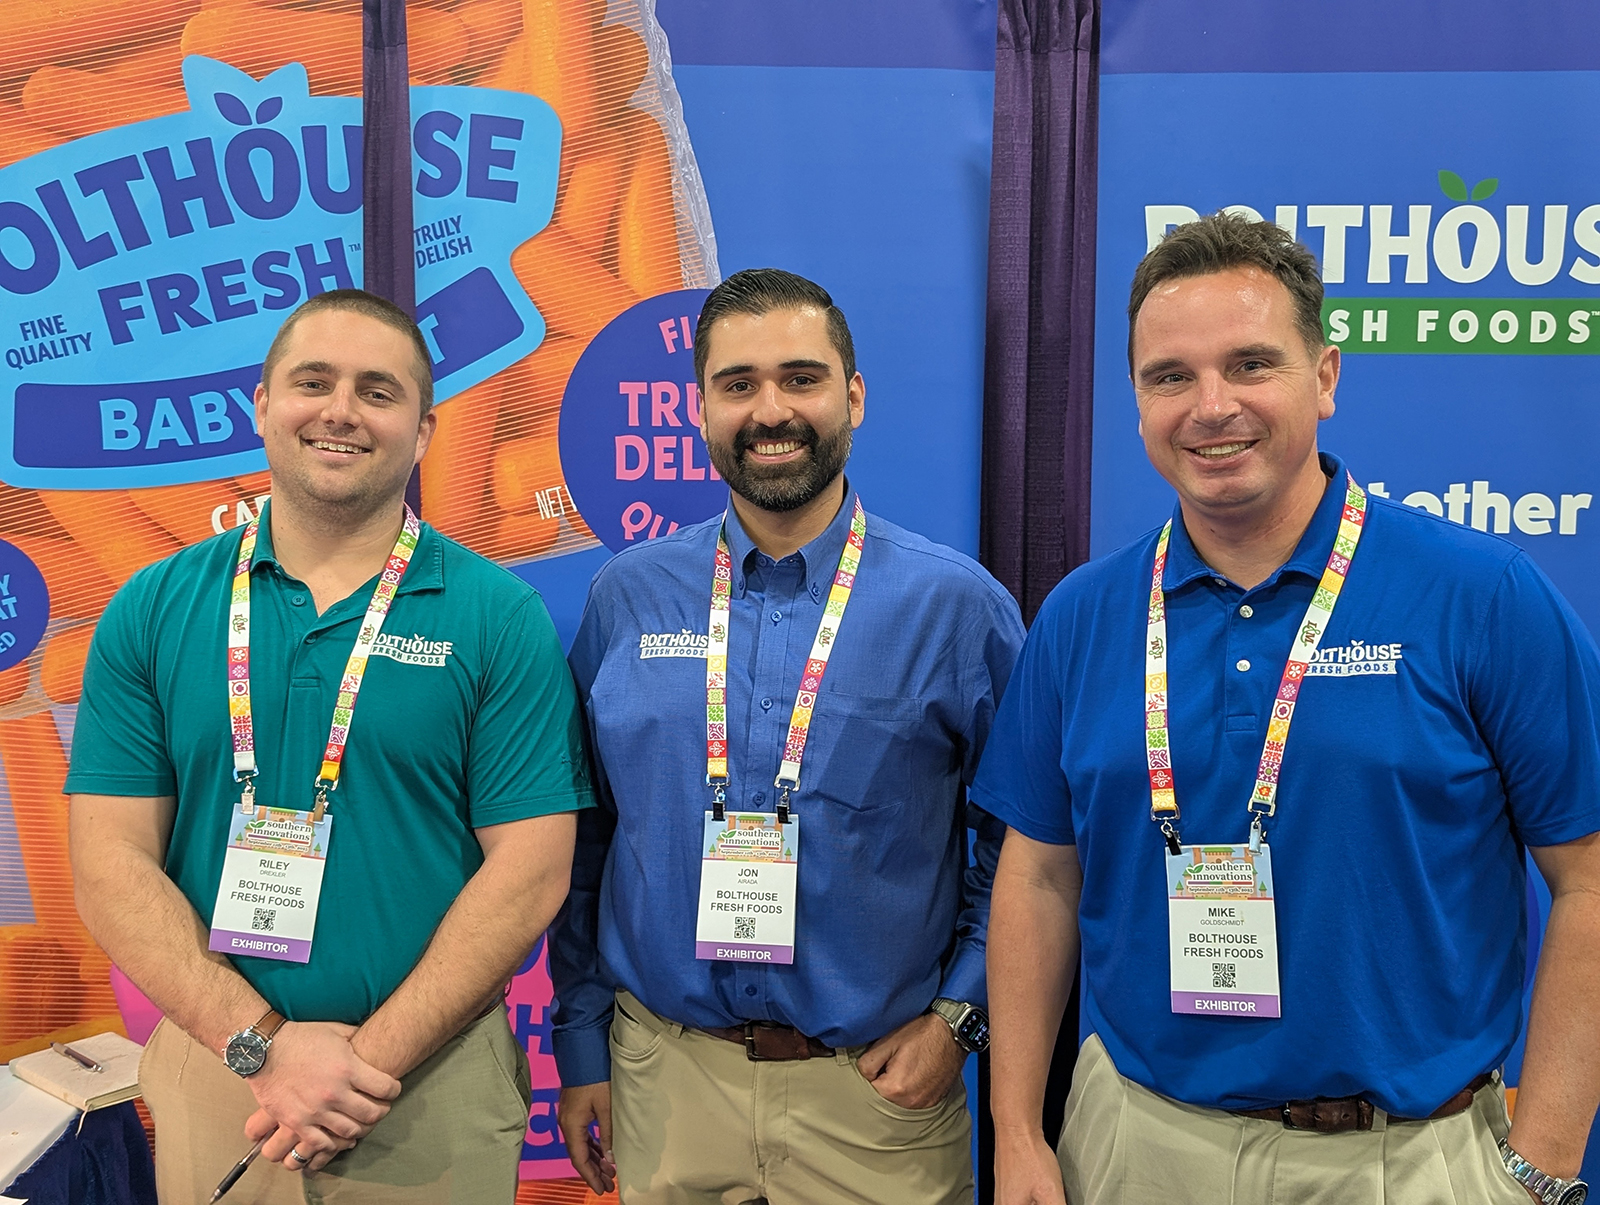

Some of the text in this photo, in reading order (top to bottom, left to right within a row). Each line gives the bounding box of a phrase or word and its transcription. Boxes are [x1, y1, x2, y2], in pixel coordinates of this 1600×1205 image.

[0, 110, 525, 295] OLTHOUSE
[413, 214, 462, 246] TRULY
[415, 235, 473, 269] DELISH
[1145, 203, 1600, 286] THOUS
[97, 237, 355, 345] FRESH
[19, 314, 67, 342] FINE
[1417, 309, 1591, 343] FOODS
[658, 315, 700, 354] FI
[5, 331, 92, 371] QUALITY
[619, 381, 701, 428] TRU
[615, 435, 721, 481] DEL
[535, 486, 565, 520] NET
[376, 633, 453, 655] OLTHOUSE
[639, 632, 709, 648] BOLTHOUS
[372, 646, 440, 664] FRESH FOODS
[645, 648, 705, 656] FRESH FOODS
[1311, 643, 1403, 663] OLTHOUSE
[1347, 664, 1389, 673] FOODS
[253, 828, 310, 841] innovations
[267, 821, 312, 833] southern
[737, 829, 780, 838] southern
[725, 837, 780, 846] innovations
[259, 859, 290, 870] RILEY
[1204, 862, 1251, 871] southern
[260, 870, 286, 878] DREXLER
[737, 868, 759, 877] JON
[1193, 871, 1252, 881] innovations
[238, 880, 302, 896] BOLTHOUSE
[716, 890, 778, 901] BOLTHOUSE
[230, 891, 305, 909] FRESH FOODS
[710, 902, 783, 914] FRESH FOODS
[1208, 907, 1236, 917] MIKE
[231, 938, 289, 953] EXHIBITOR
[1189, 933, 1257, 944] BOLTHOUSE
[716, 948, 772, 960] EXHIBITOR
[1183, 947, 1264, 958] FRESH FOODS
[1195, 999, 1256, 1012] EXHIBITOR
